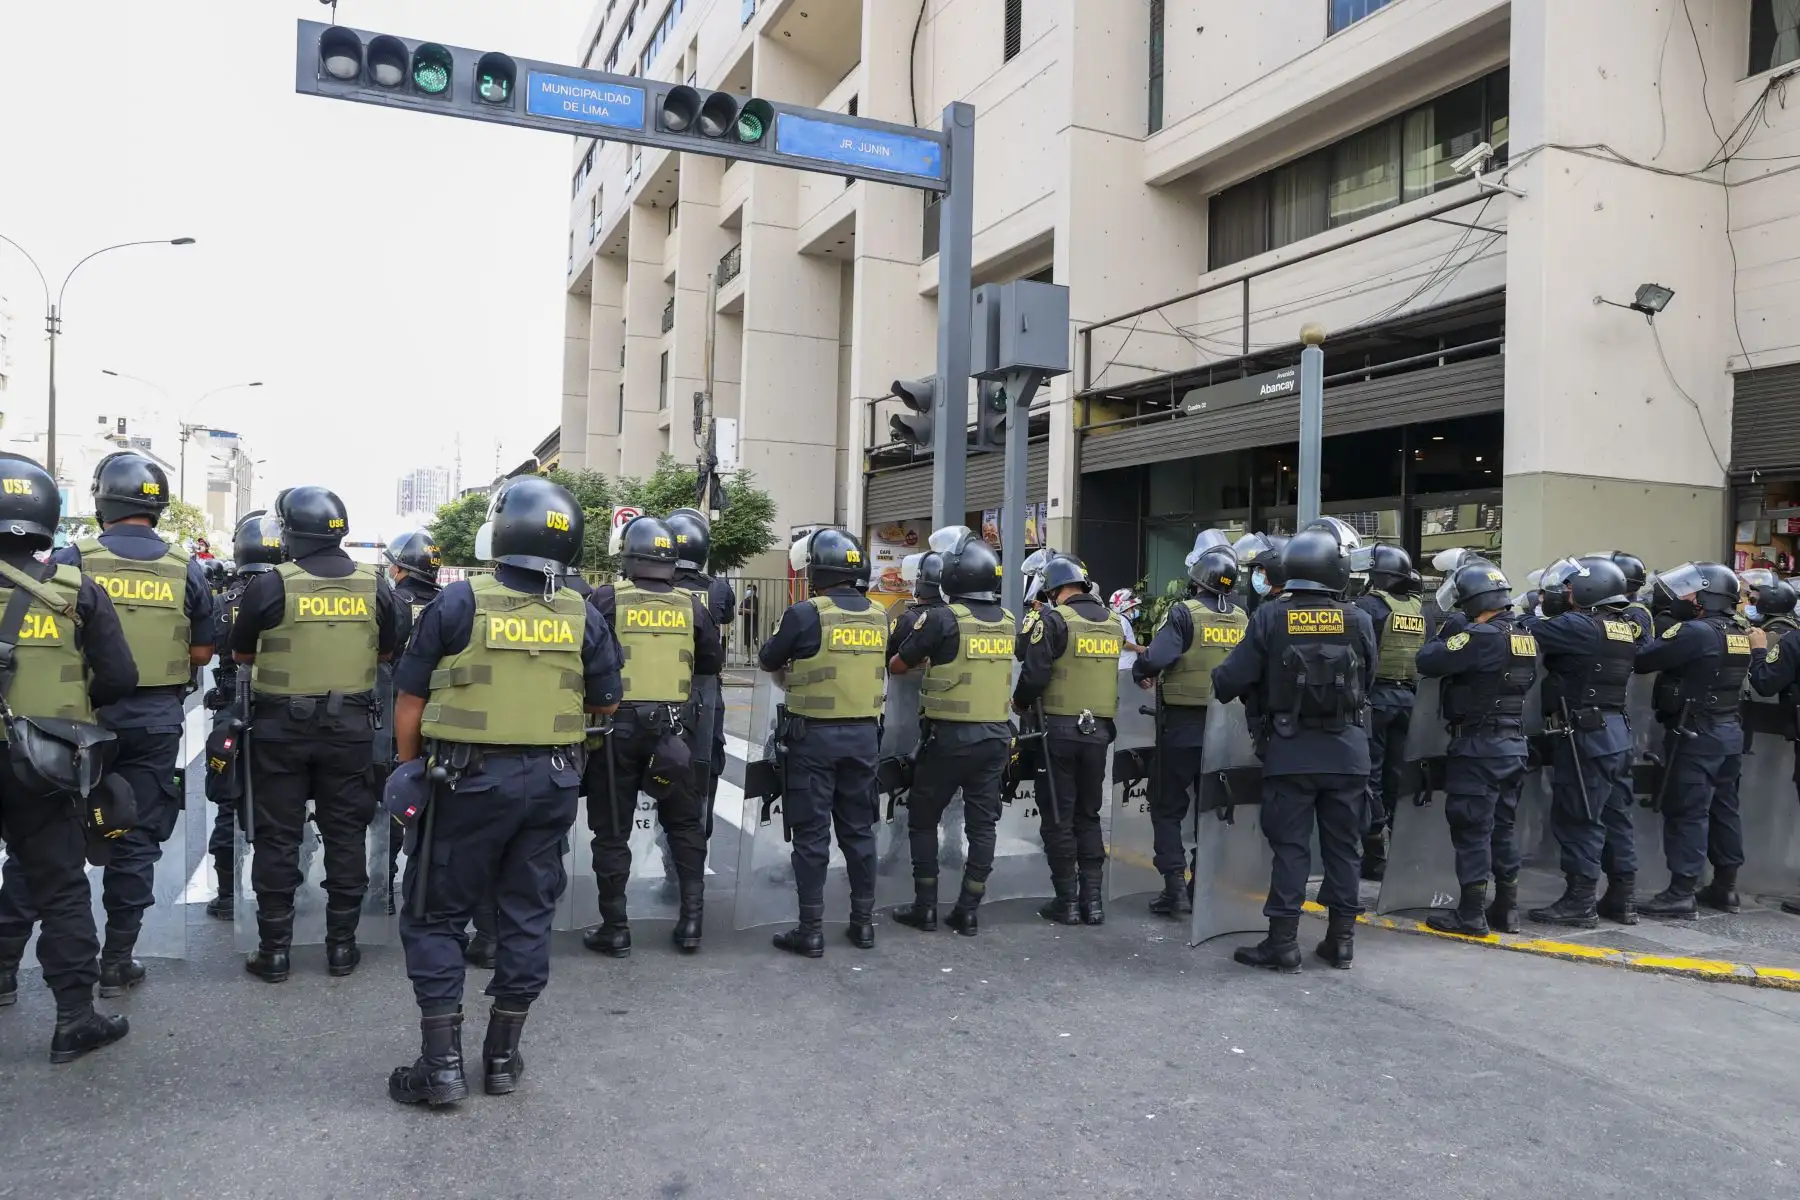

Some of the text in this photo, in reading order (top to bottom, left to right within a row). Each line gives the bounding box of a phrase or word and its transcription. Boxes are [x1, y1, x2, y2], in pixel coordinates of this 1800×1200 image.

[480, 75, 507, 97] 21
[541, 82, 631, 105] MUNICIPALIDAD
[563, 101, 609, 117] DE LIMA
[839, 138, 855, 151] JR.
[1277, 370, 1294, 379] Avenida
[1260, 380, 1294, 395] Abancay
[3, 479, 33, 495] USE
[143, 482, 160, 495] USE
[328, 518, 345, 529] USE
[546, 510, 570, 532] USE
[676, 534, 688, 544] SE
[846, 550, 861, 563] USE
[94, 575, 174, 602] POLICIA
[1220, 576, 1232, 586] USE
[299, 596, 368, 616] POLICIA
[627, 608, 687, 628] POLICIA
[1289, 611, 1342, 624] POLICIA
[1394, 615, 1424, 631] POLICIA
[490, 617, 574, 644] POLICIA
[1318, 624, 1342, 632] ESPECIALES
[832, 628, 883, 646] POLICIA
[969, 638, 1013, 655] POLICIA
[1078, 638, 1119, 655] POLICIA
